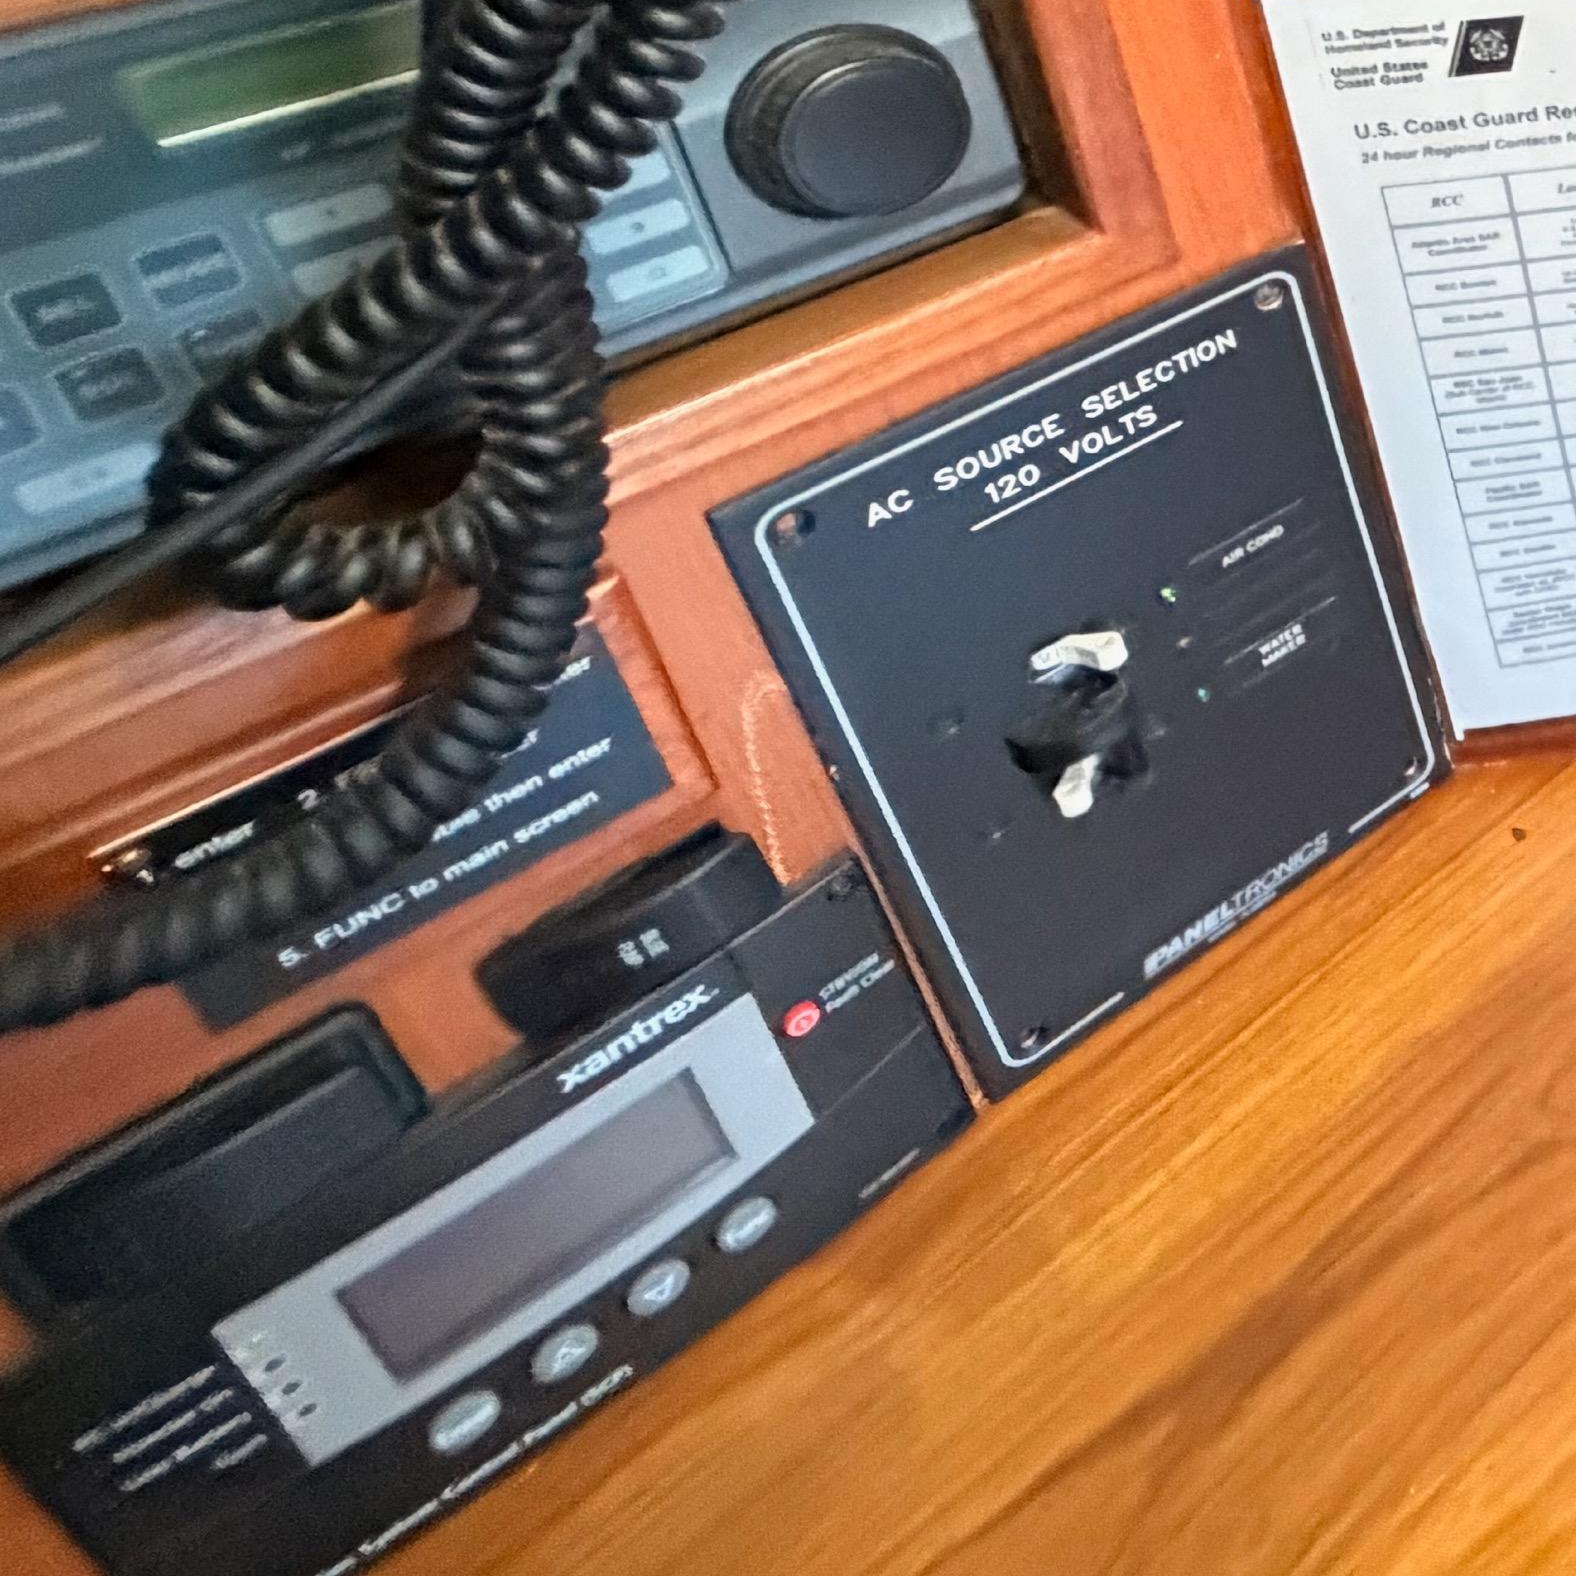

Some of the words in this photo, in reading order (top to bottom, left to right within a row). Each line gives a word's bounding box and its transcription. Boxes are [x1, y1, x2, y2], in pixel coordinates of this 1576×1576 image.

[1324, 39, 1392, 55] Homeland
[1395, 36, 1449, 50] Security
[1352, 23, 1429, 40] Department
[1330, 61, 1379, 78] United
[1383, 59, 1429, 74] States
[1333, 75, 1376, 90] Coast
[1380, 71, 1424, 86] Guard
[1354, 121, 1398, 140] U.S.
[1403, 115, 1468, 135] Coast
[1473, 107, 1538, 128] Guard
[1361, 151, 1378, 164] 24
[1383, 147, 1420, 162] hour
[1423, 139, 1490, 158] Regional
[1495, 134, 1562, 151] Contacts
[1430, 193, 1463, 209] RCC
[863, 486, 914, 529] AC
[932, 412, 1062, 493] SOURCE
[1080, 328, 1238, 418] SELECTION
[983, 464, 1042, 504] 120
[1057, 404, 1159, 469] VOLTS
[1222, 547, 1245, 568] AIR
[1246, 524, 1285, 554] COND
[1258, 623, 1303, 656] WATER
[484, 774, 543, 813] then
[548, 735, 613, 780] enter
[277, 944, 308, 971] 5.
[313, 893, 406, 951] FUNC
[408, 869, 439, 899] to
[443, 838, 509, 882] main
[513, 790, 598, 844] screen
[1143, 830, 1329, 980] PANELTRONICS
[556, 983, 714, 1094] xantrex
